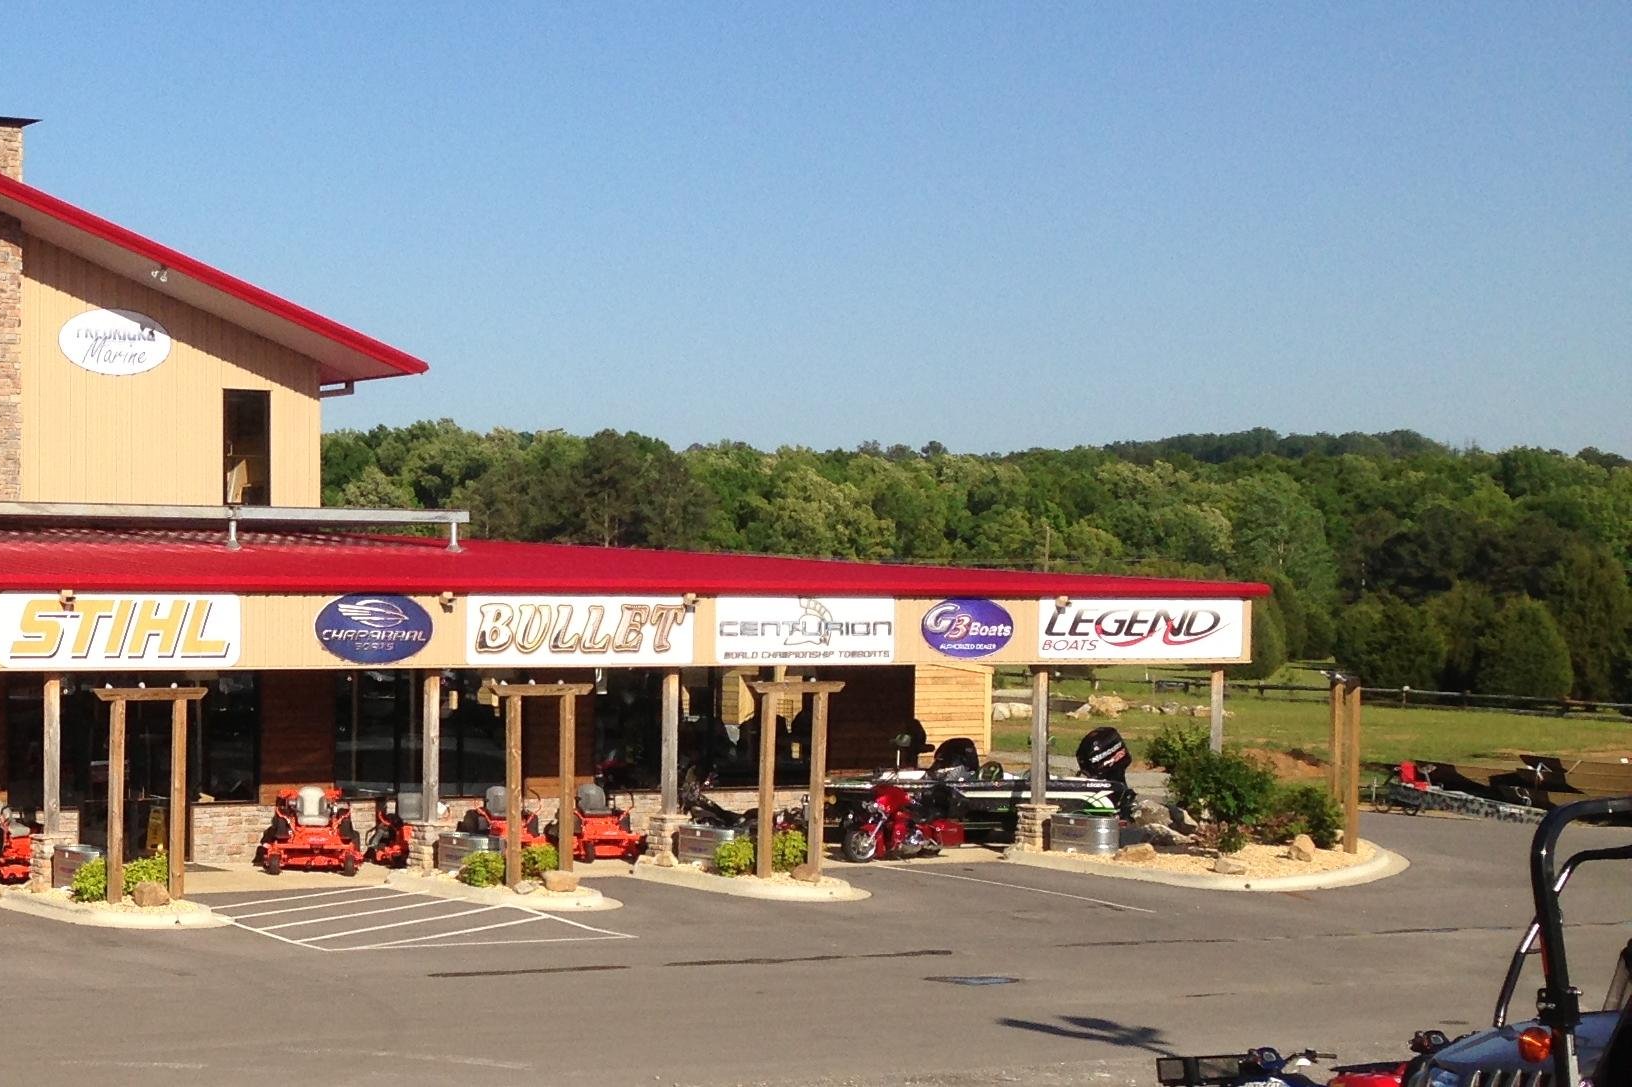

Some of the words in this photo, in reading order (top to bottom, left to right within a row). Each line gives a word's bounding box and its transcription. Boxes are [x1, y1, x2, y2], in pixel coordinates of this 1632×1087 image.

[82, 335, 147, 365] Marine
[10, 599, 230, 659] STIHL
[475, 603, 686, 652] BULLET
[969, 621, 1012, 637] Boats
[1044, 607, 1221, 638] LEGEND
[724, 651, 759, 660] WORLD
[761, 651, 835, 659] CHAMPIONSHIP
[1041, 639, 1099, 651] BOATS
